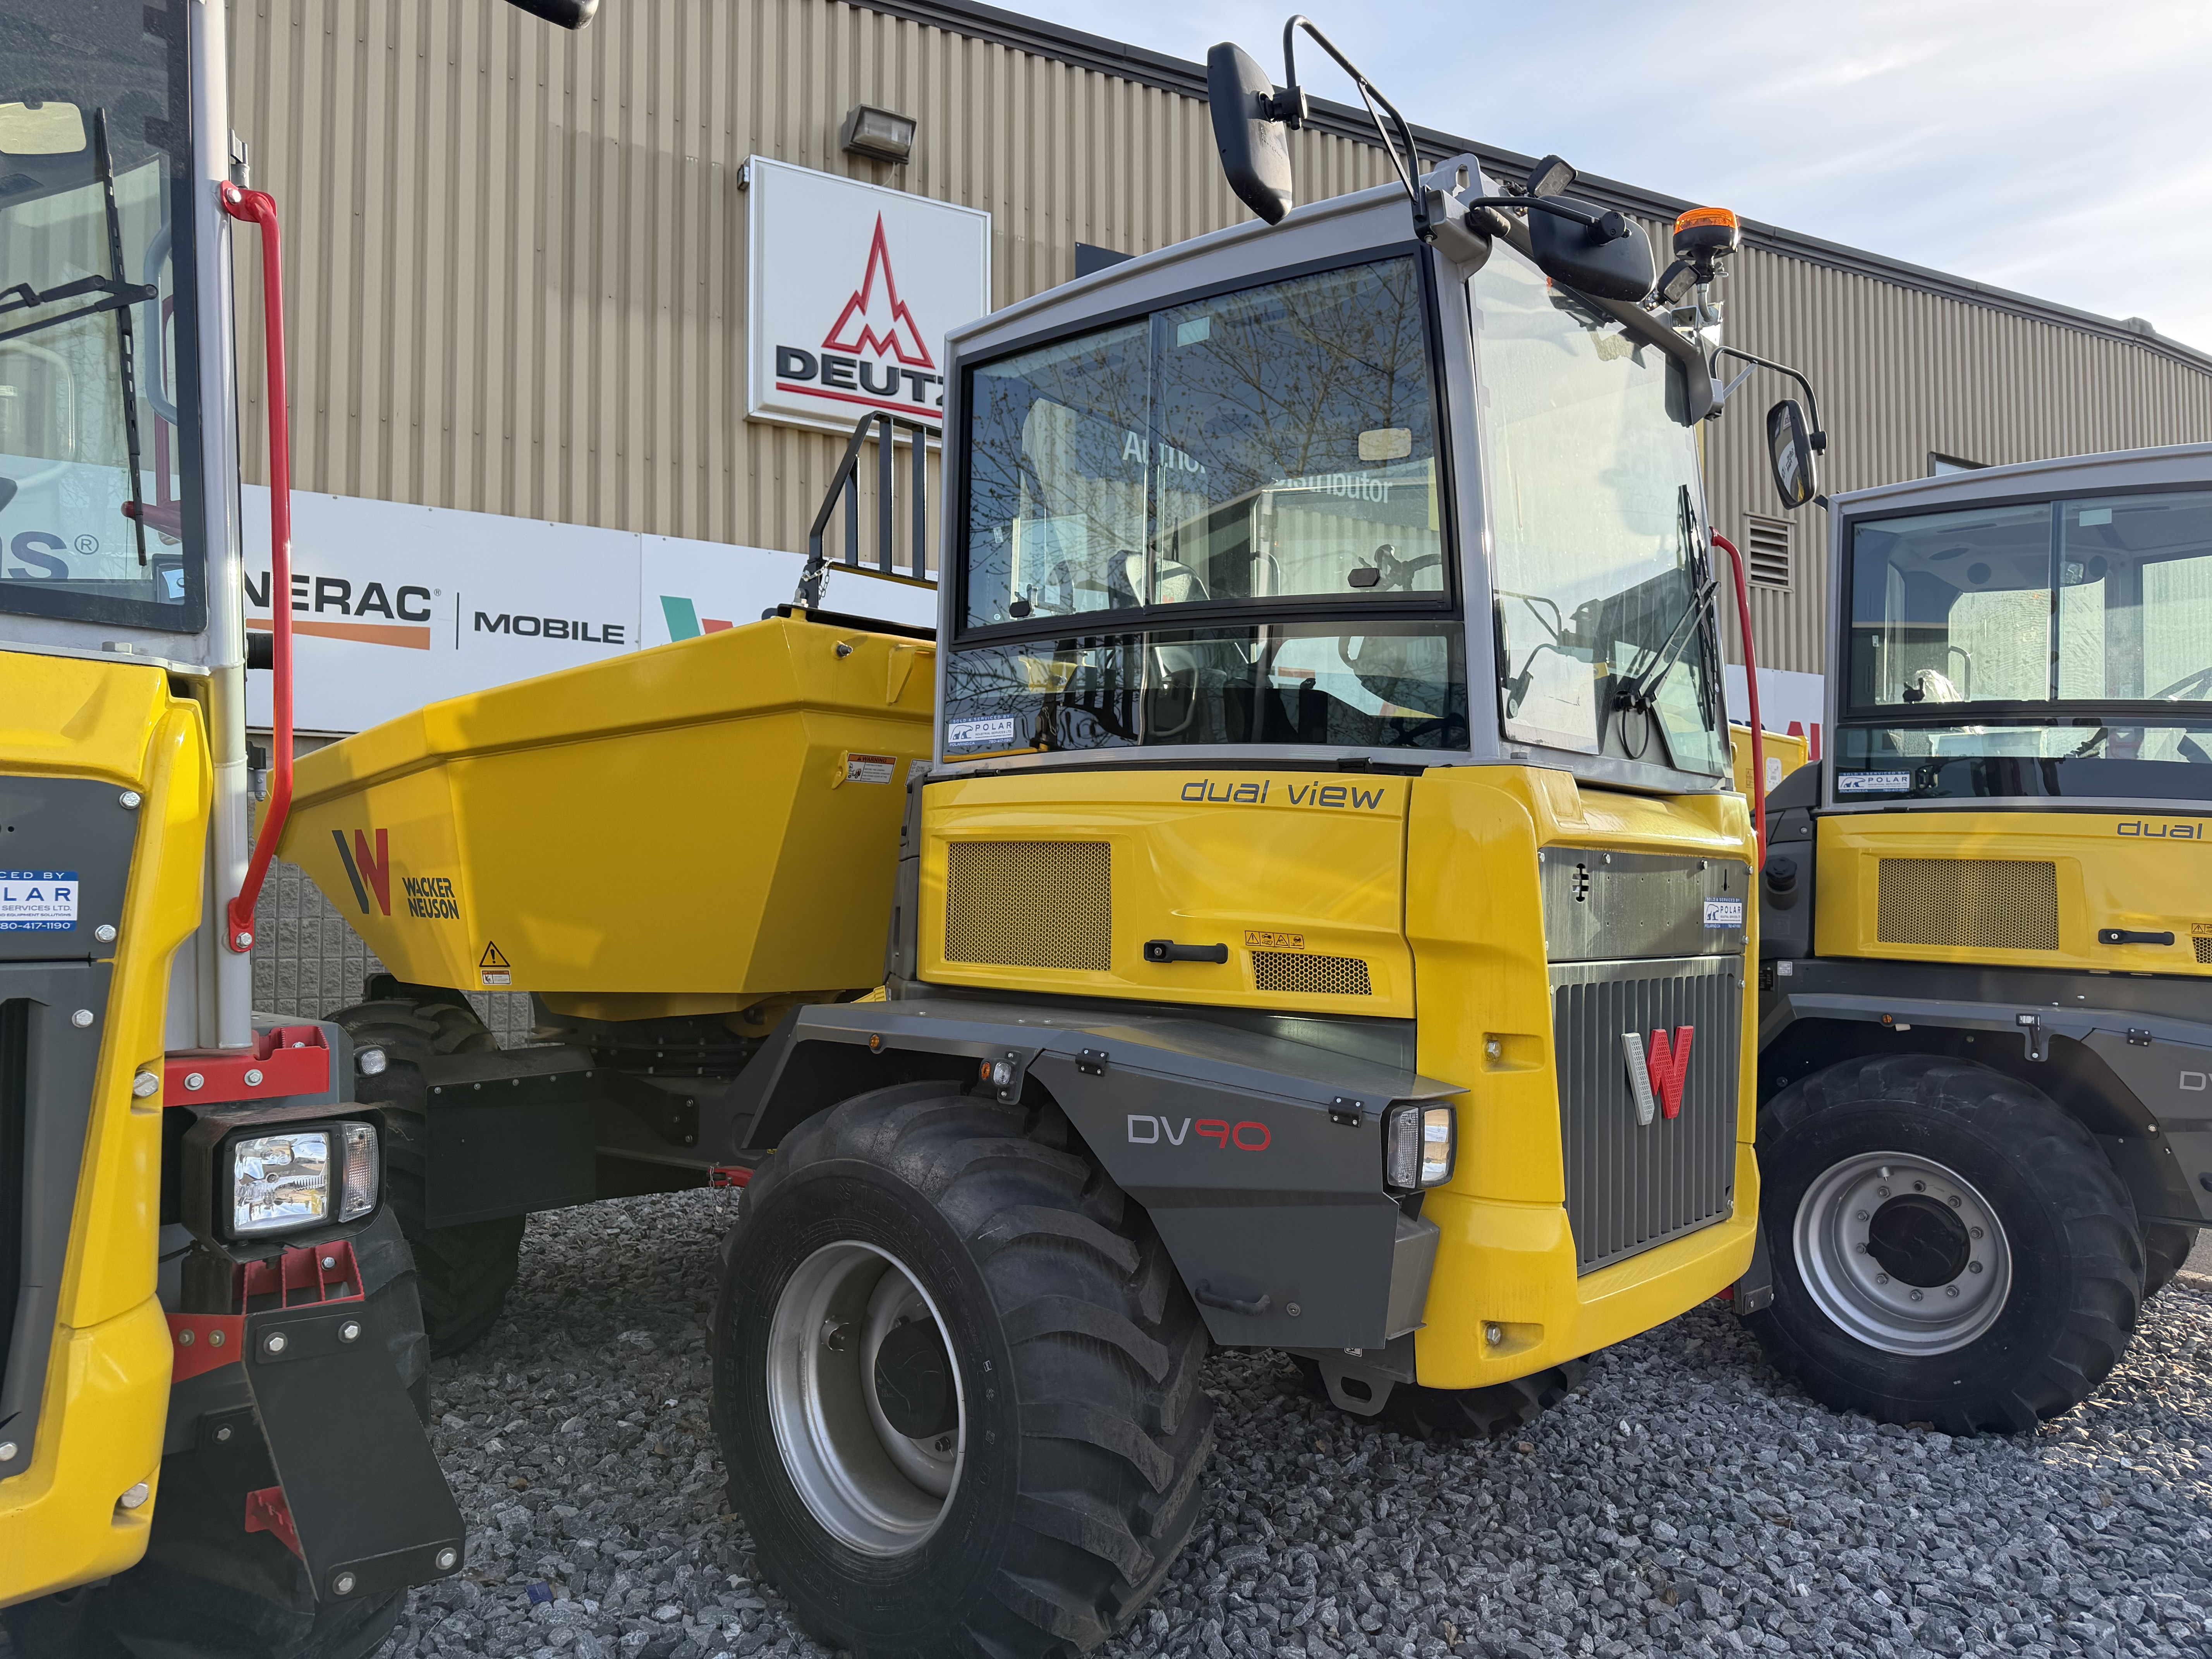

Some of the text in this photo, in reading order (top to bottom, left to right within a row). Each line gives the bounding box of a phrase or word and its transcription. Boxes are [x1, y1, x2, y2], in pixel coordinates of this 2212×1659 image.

[776, 345, 943, 405] DEUT
[474, 611, 625, 644] MOBILE
[975, 722, 1012, 732] POLAR
[1181, 779, 1384, 809] dual view
[2117, 821, 2203, 839] dual
[4, 887, 71, 902] LAR
[402, 878, 455, 898] WACKER
[407, 898, 460, 919] NEUSON
[2179, 1071, 2212, 1091] D
[1127, 1114, 1271, 1151] DV90
